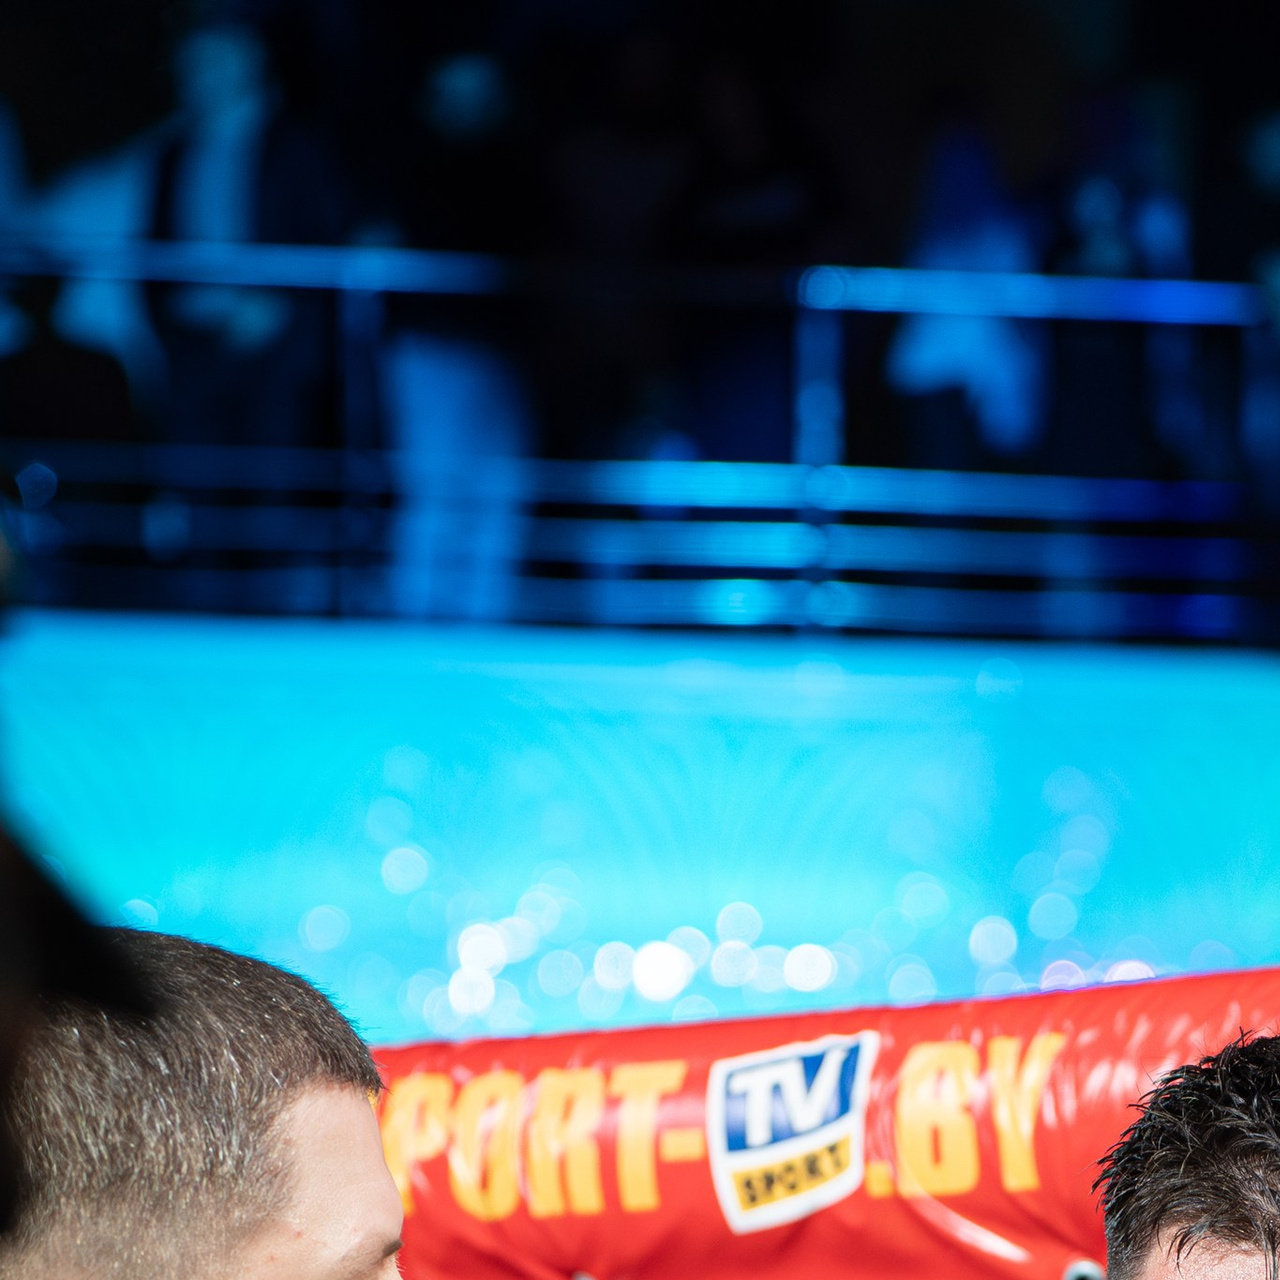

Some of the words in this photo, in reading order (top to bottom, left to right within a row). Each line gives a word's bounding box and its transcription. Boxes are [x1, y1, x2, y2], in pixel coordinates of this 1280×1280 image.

[367, 1060, 704, 1221] PORT-
[727, 1046, 850, 1148] TV
[743, 1143, 844, 1204] SPORT
